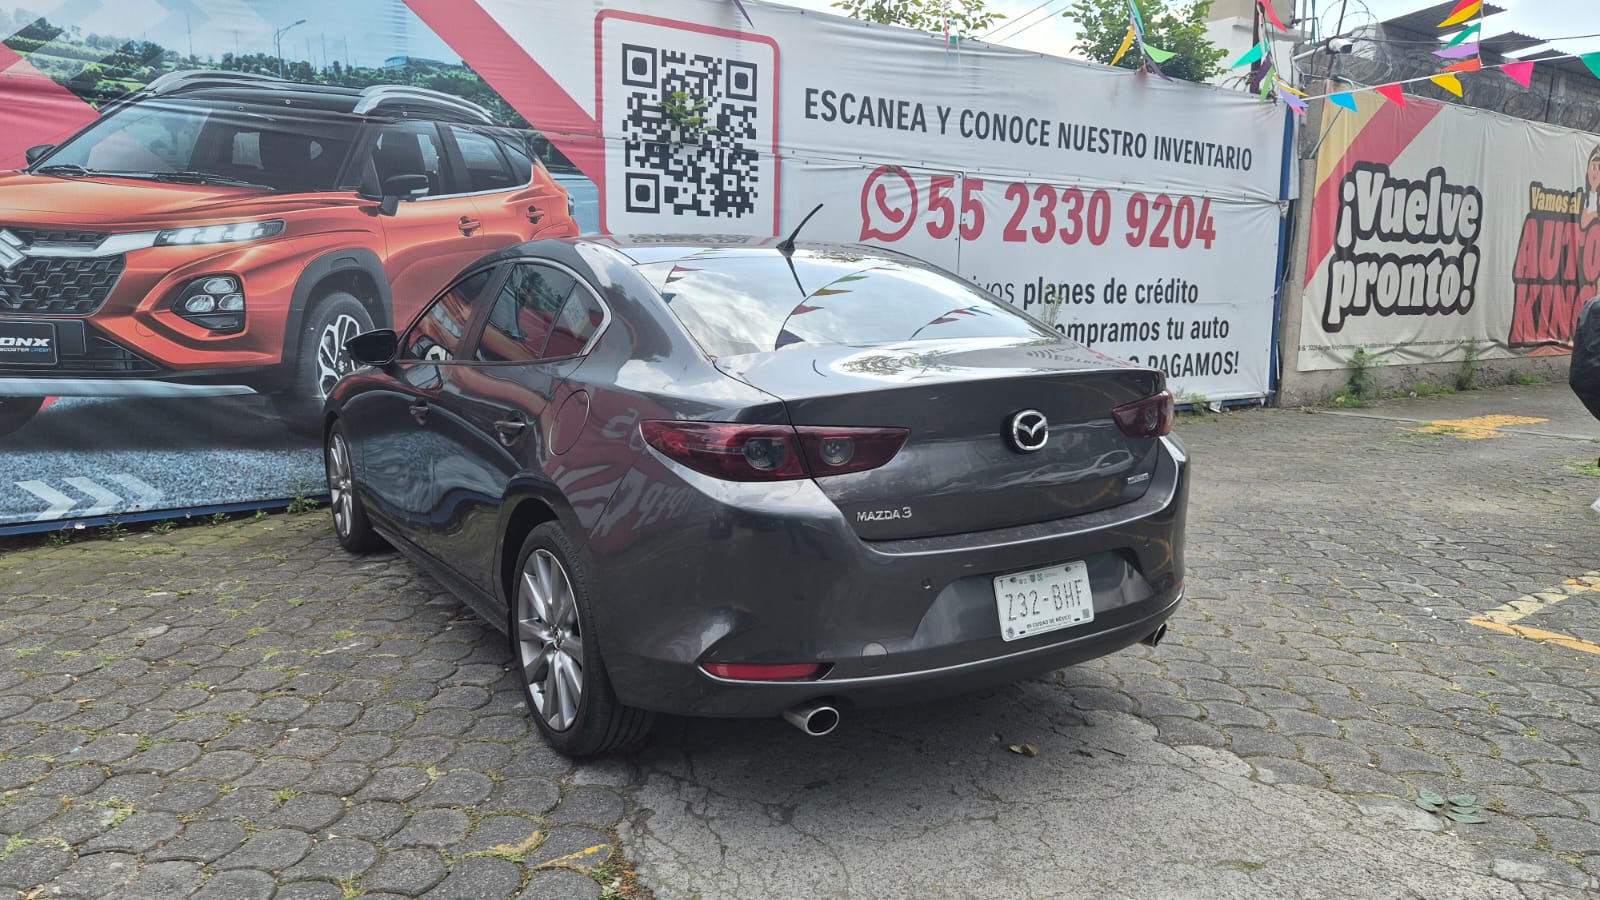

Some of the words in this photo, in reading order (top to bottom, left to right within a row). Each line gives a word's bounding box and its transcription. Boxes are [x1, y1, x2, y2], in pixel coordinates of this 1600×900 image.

[805, 87, 927, 133] ESCANEA
[937, 105, 952, 135] Y
[959, 109, 1051, 147] CONOCE
[1057, 122, 1147, 159] NUESTRO
[1153, 135, 1252, 172] INVENTARIO
[926, 175, 985, 242] 55
[1003, 182, 1111, 246] 2330
[1126, 192, 1216, 250] 9204
[1336, 167, 1481, 249] ¡Vuelve
[1531, 186, 1569, 213] Vamos
[1570, 191, 1582, 215] al
[1023, 276, 1095, 310] planes
[1103, 277, 1127, 305] de
[1135, 277, 1199, 305] crédito
[1326, 250, 1479, 326] pronto!
[1167, 317, 1185, 341] tu
[1190, 316, 1230, 340] auto
